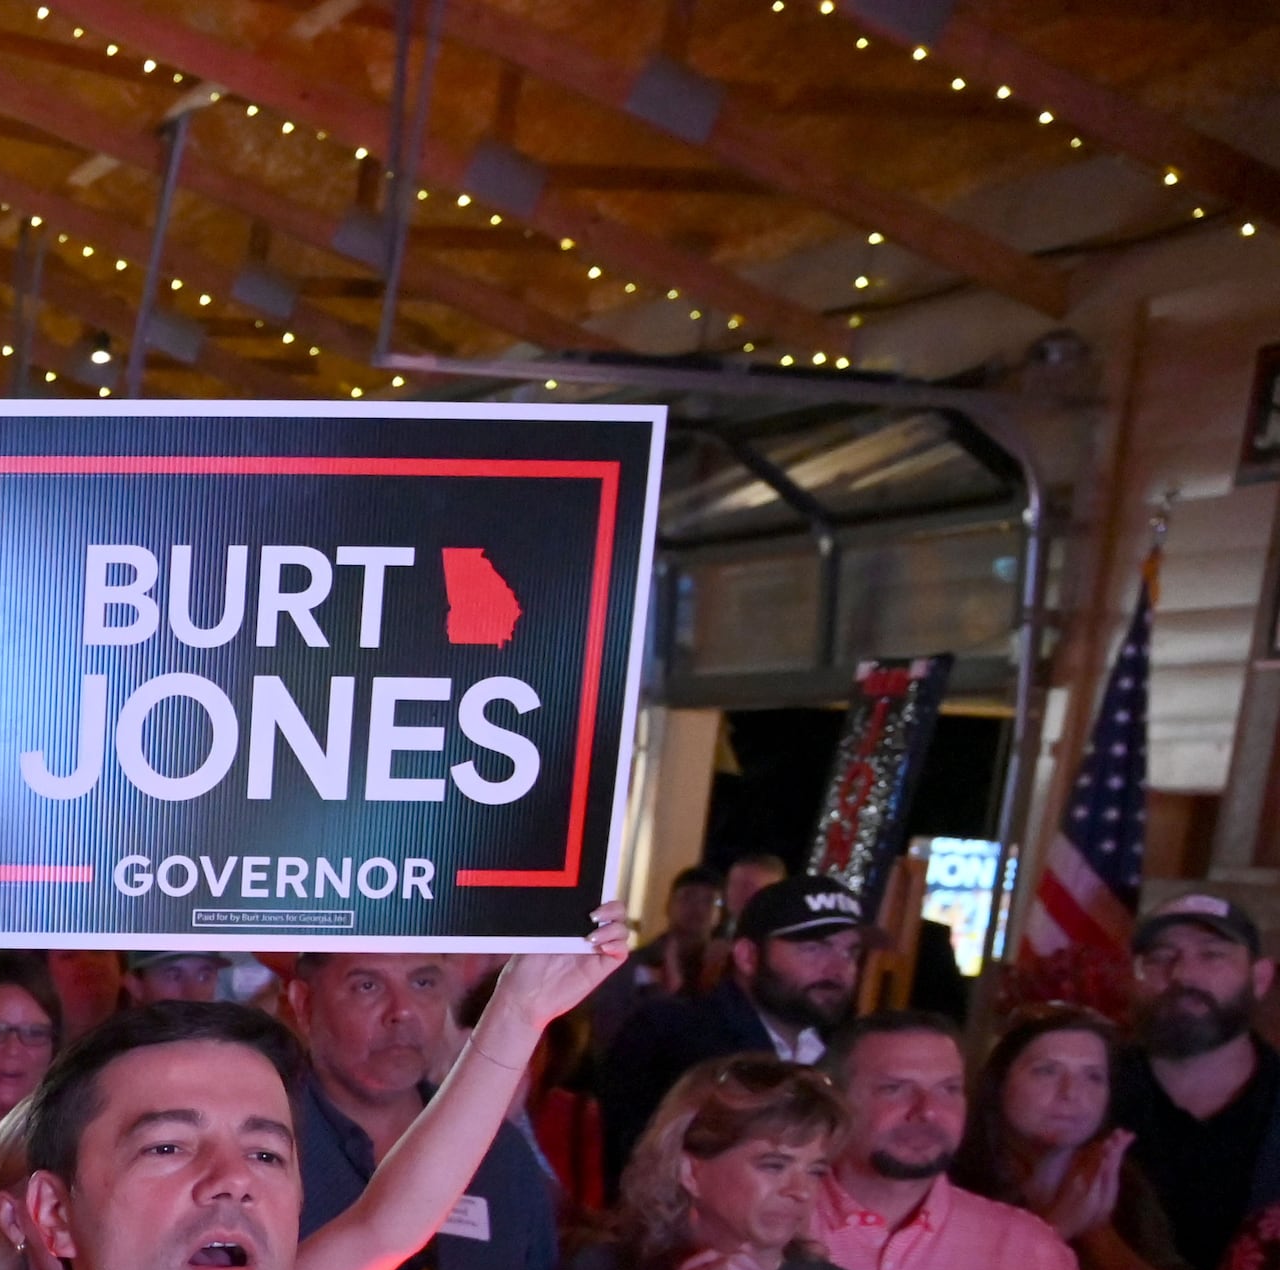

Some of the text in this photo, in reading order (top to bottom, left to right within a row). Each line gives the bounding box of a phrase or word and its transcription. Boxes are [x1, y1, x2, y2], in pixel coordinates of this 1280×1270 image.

[82, 543, 415, 650] BURT
[19, 672, 543, 806] JONES
[113, 854, 436, 901] GOVERNOR
[196, 913, 215, 922] Paid
[216, 913, 229, 922] for
[230, 913, 240, 924] by
[241, 913, 260, 922] Burt
